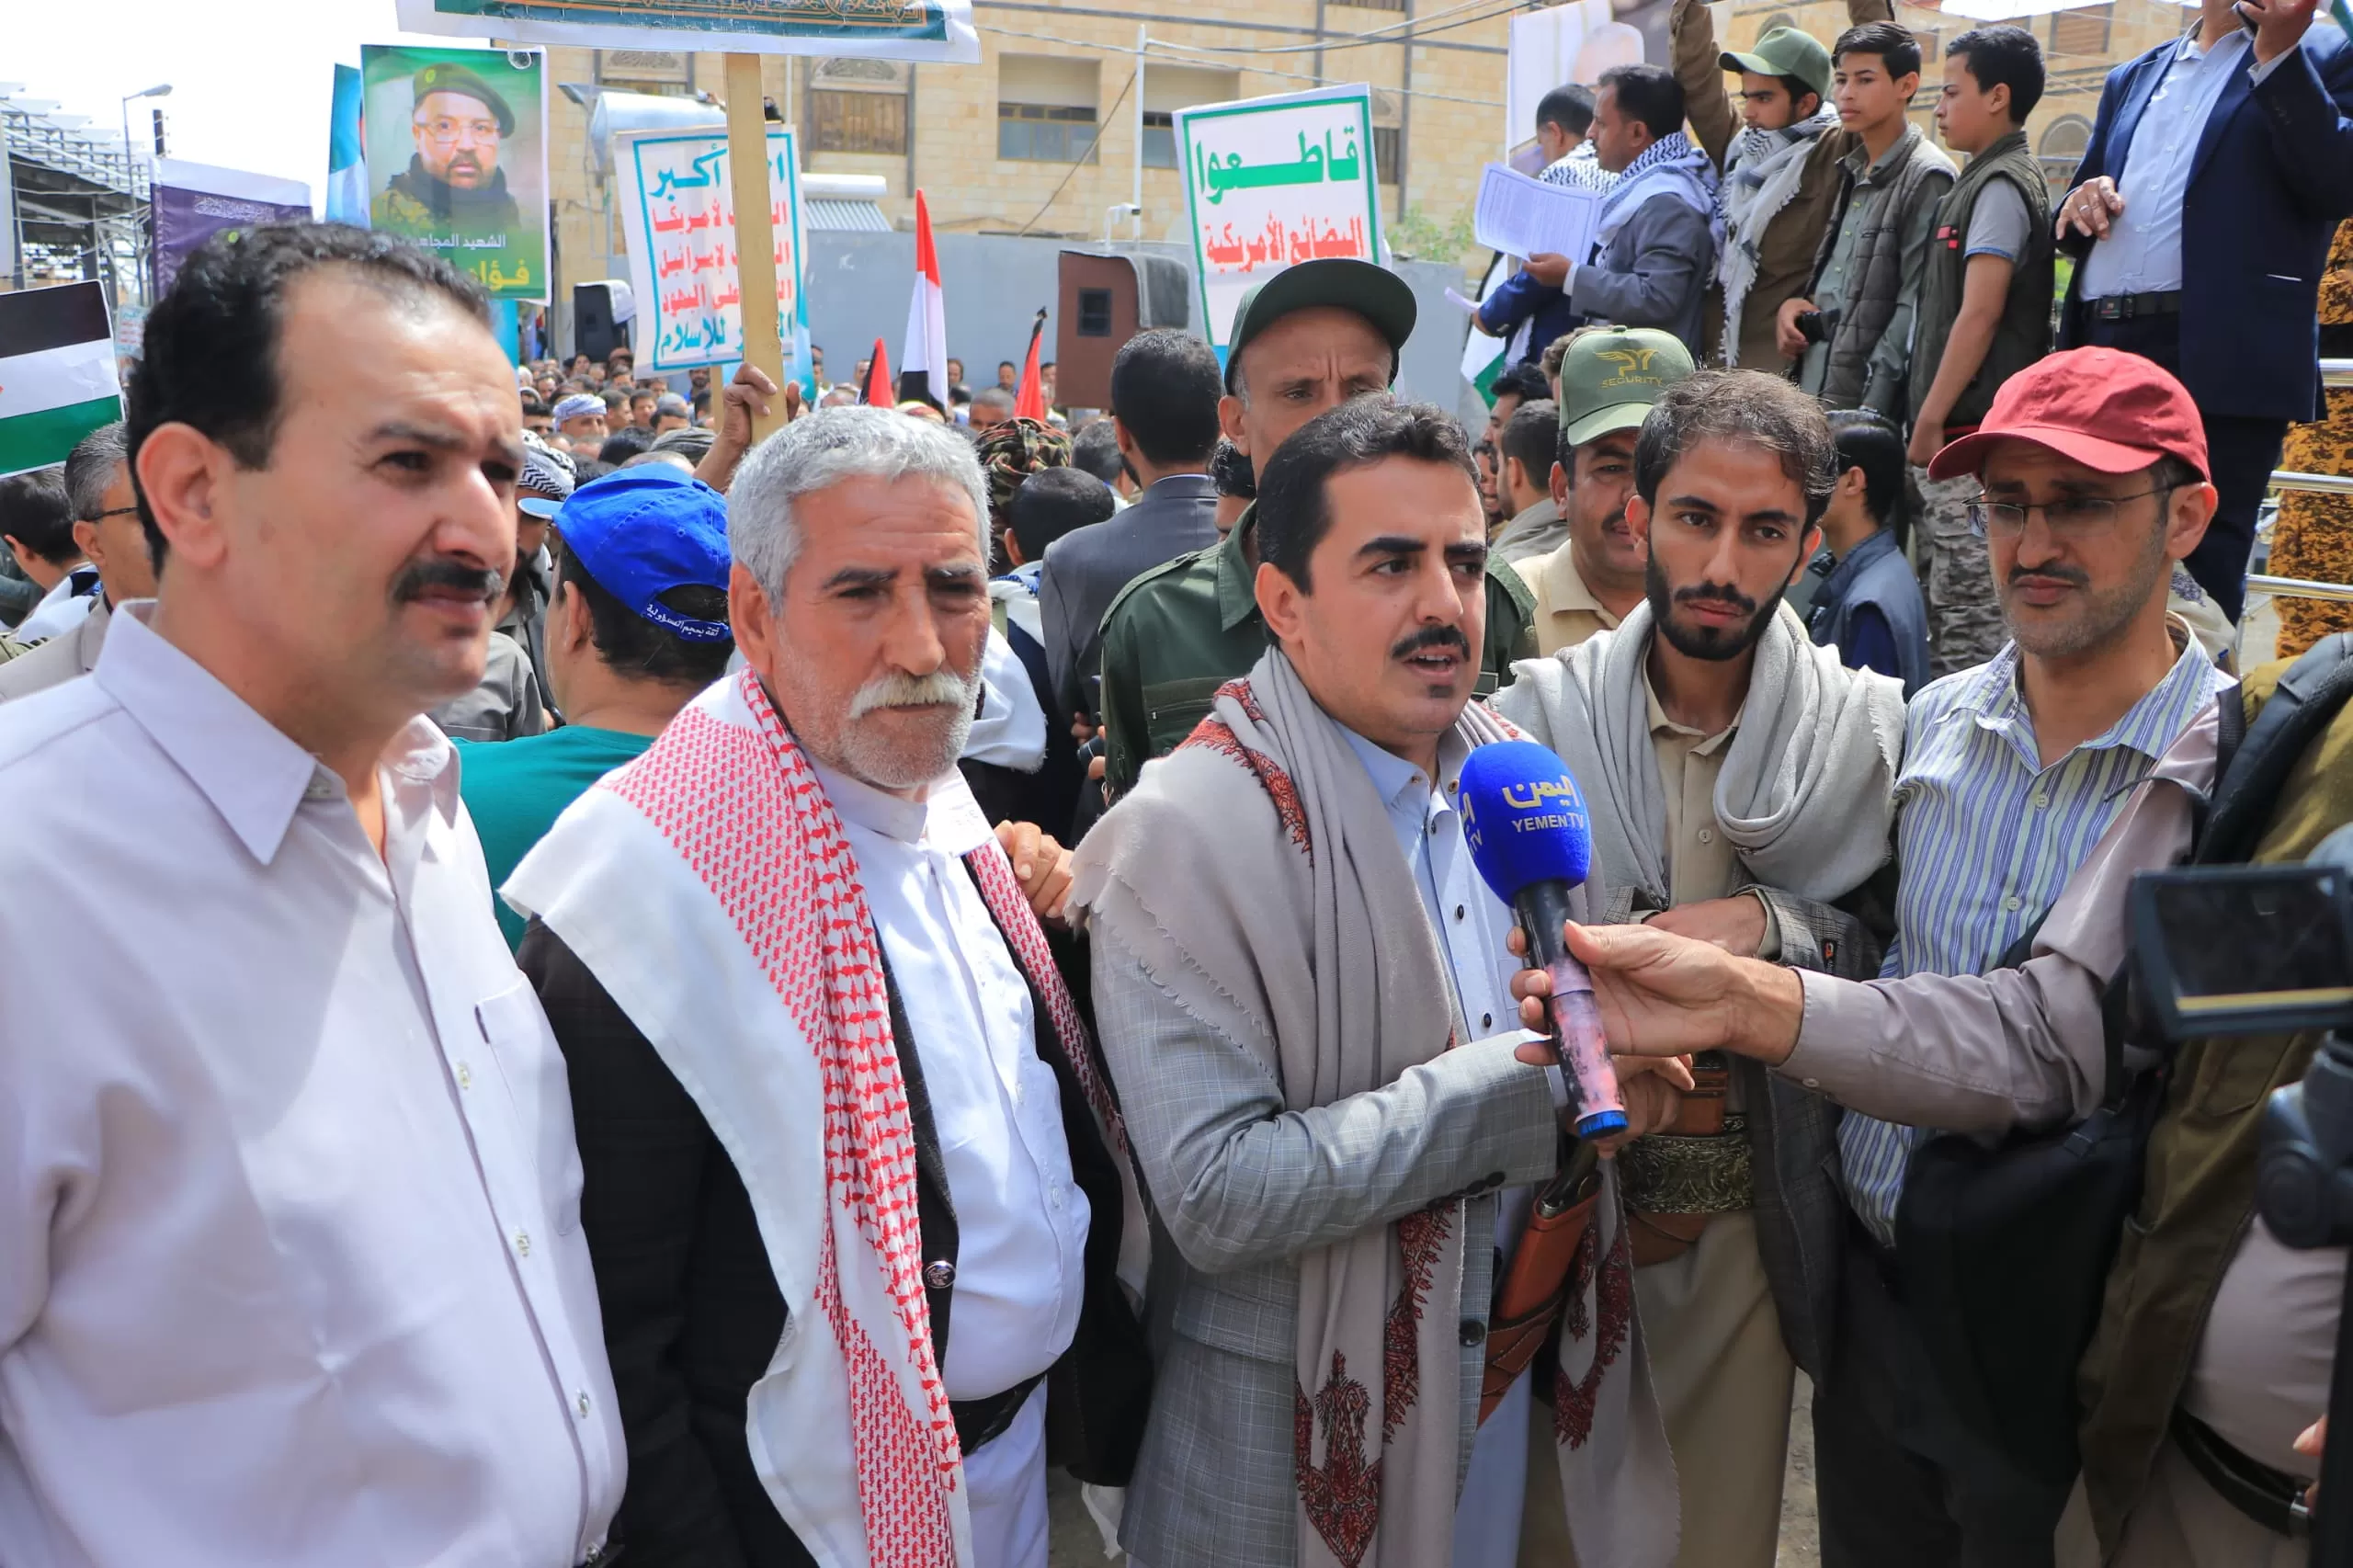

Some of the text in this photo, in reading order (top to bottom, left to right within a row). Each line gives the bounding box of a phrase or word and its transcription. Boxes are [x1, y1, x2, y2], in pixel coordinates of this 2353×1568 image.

[648, 142, 728, 202] أكبر
[1196, 125, 1360, 205] قاطعوا
[652, 197, 722, 234] لأمريكا
[418, 233, 506, 251] الشهيد المجاه
[1204, 209, 1365, 274] البضائع الأمريكية
[659, 242, 725, 279] لإسرائيل
[663, 282, 707, 318] اليهود
[661, 315, 727, 358] للإسلام
[1601, 375, 1663, 389] SECURITY
[1502, 774, 1581, 809] اليمن
